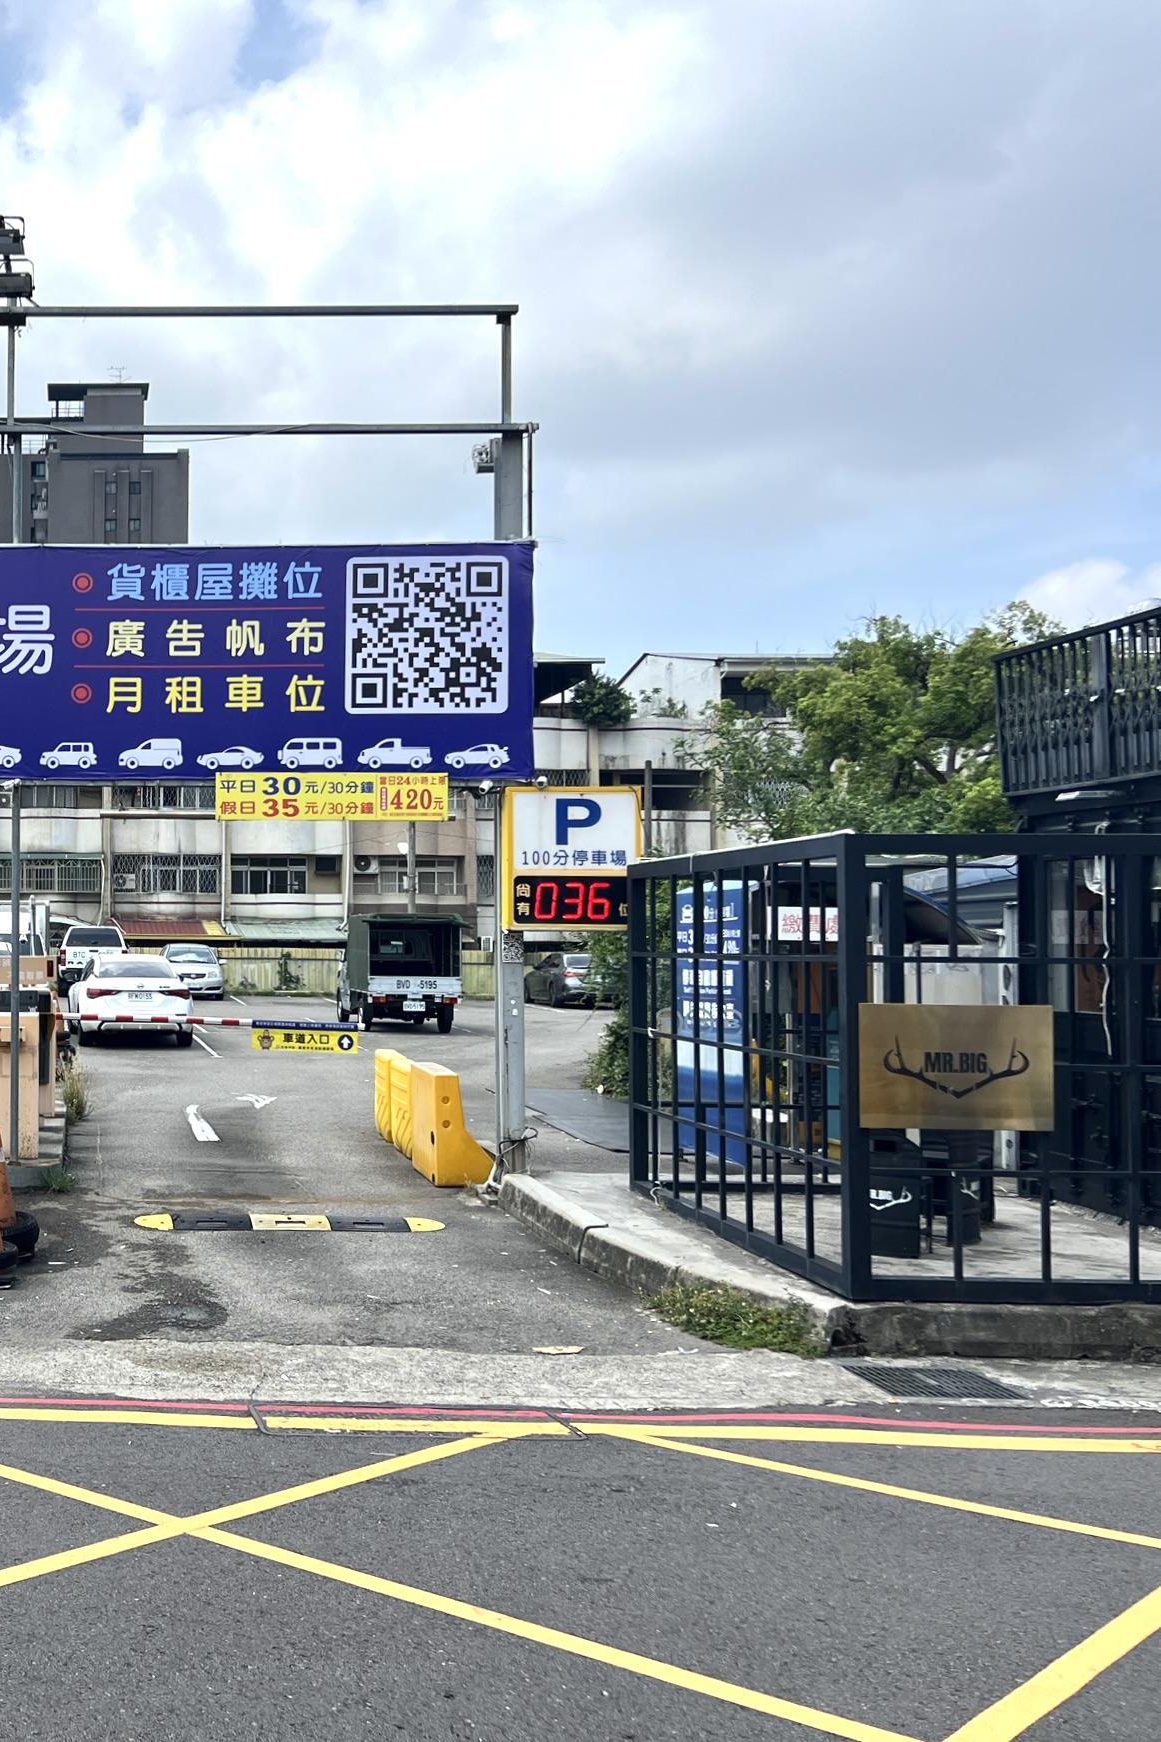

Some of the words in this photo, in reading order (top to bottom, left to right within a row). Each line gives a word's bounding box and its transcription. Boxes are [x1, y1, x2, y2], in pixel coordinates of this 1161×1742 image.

[106, 561, 323, 601] 貨櫃屋攤位
[105, 618, 326, 657] 廣告帆布
[105, 674, 326, 714] 月租車位
[555, 798, 602, 846] P
[522, 849, 627, 866] 100分停車場
[516, 883, 531, 916] 尚有
[534, 882, 611, 920] 036
[283, 1033, 330, 1044] 車道入口
[924, 1051, 988, 1074] MR.BIG
